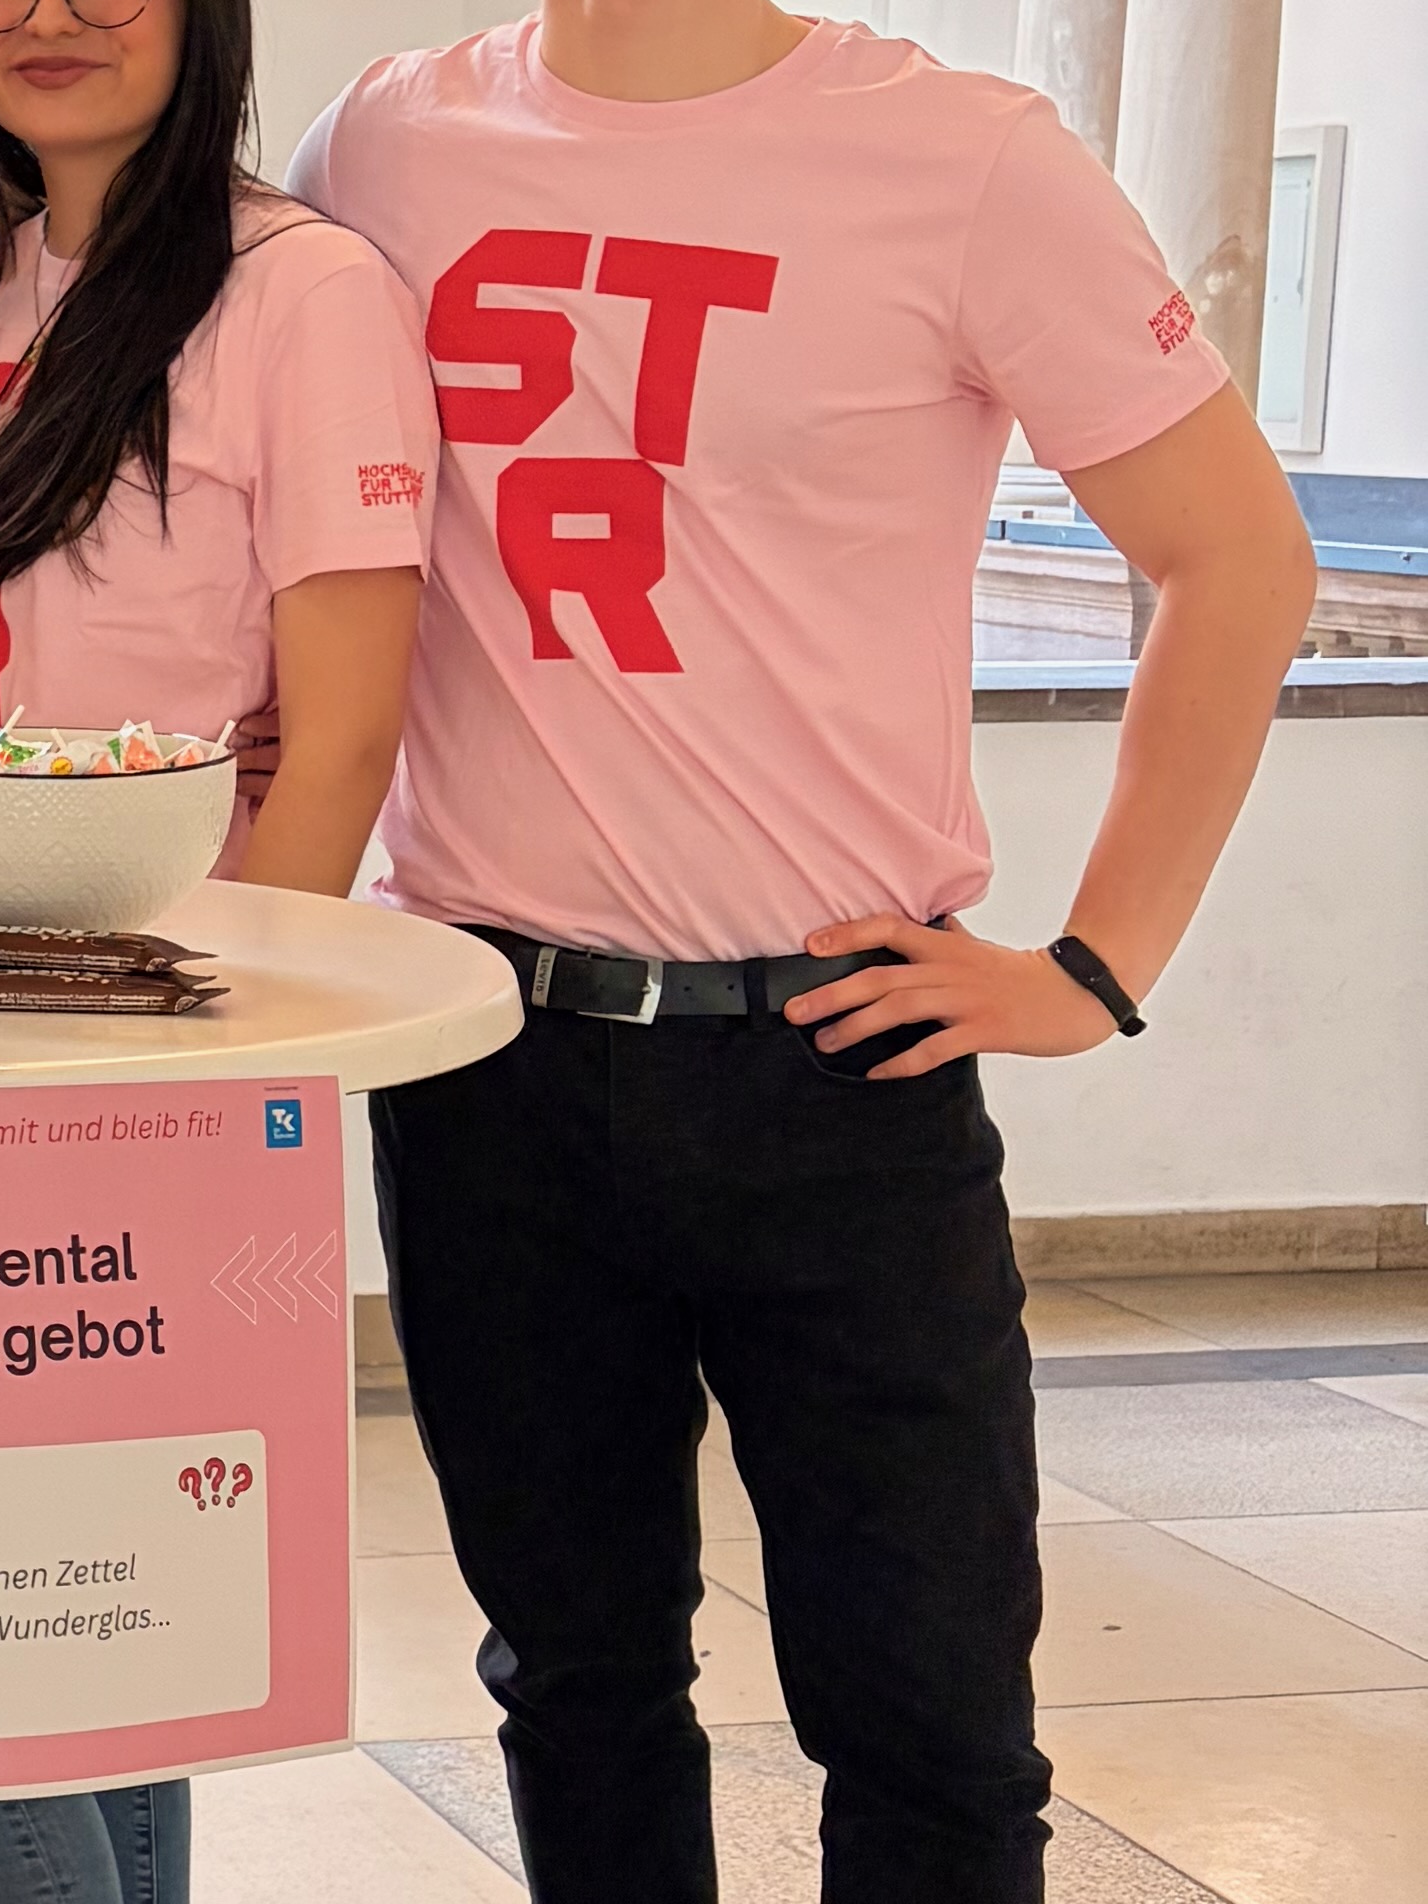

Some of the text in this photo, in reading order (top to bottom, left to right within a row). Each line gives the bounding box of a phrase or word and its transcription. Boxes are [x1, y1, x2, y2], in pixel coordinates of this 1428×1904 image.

[426, 229, 780, 467] ST
[497, 457, 685, 673] R
[48, 1115, 102, 1143] und
[111, 1112, 178, 1141] bleib
[187, 1111, 222, 1138] fit!
[55, 1553, 136, 1587] Zettel
